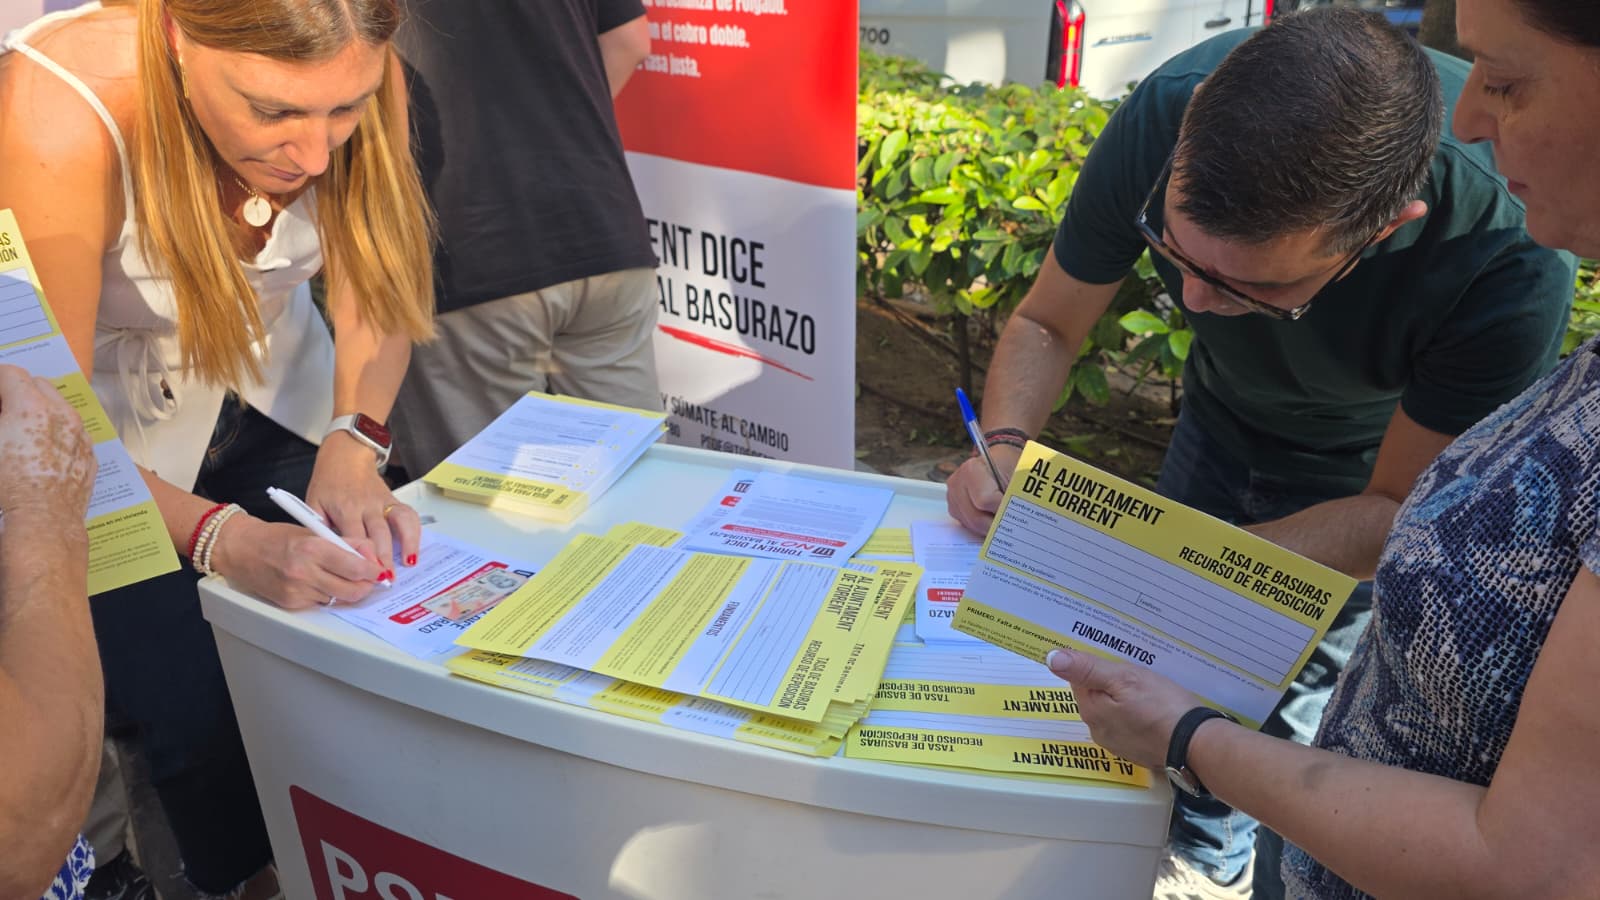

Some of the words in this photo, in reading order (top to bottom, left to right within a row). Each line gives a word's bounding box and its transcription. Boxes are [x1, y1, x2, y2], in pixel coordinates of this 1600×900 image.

[701, 231, 766, 289] DICE
[686, 283, 817, 356] BASURAZO
[670, 396, 718, 429] SÚMATE
[721, 413, 738, 435] AL
[740, 419, 789, 452] CAMBIO
[1029, 458, 1051, 480] AL
[1052, 467, 1165, 526] AJUNTAMENT
[1022, 475, 1047, 498] DE
[1048, 484, 1123, 530] TORRENT
[839, 573, 858, 582] DE
[856, 575, 875, 585] AL
[1178, 546, 1235, 580] RECURSO
[1232, 570, 1254, 588] DE
[1250, 575, 1327, 621] REPOSICIÓN
[1219, 546, 1253, 571] TASA
[1251, 561, 1273, 579] DE
[1270, 569, 1332, 606] BASURAS
[826, 583, 852, 614] TORRENT
[836, 584, 869, 632] AJUNTAMENT
[705, 601, 740, 637] FUNDAMENTOS
[1071, 620, 1156, 666] FUNDAMENTOS
[801, 639, 822, 664] RECURSO
[795, 664, 809, 673] DE
[811, 657, 829, 672] TASA
[806, 671, 821, 681] DE
[792, 680, 816, 710] BASURAS
[915, 682, 930, 692] DE
[931, 684, 975, 696] RECURSO
[907, 691, 922, 701] DE
[923, 691, 950, 702] TASA
[859, 736, 908, 749] BASURAS
[919, 732, 934, 742] DE
[936, 735, 983, 747] RECURSO
[911, 741, 925, 750] DE
[926, 741, 955, 753] TASA
[1041, 743, 1109, 760] TORRENT
[1012, 751, 1111, 772] AJUNTAMENT
[1114, 761, 1134, 776] AL
